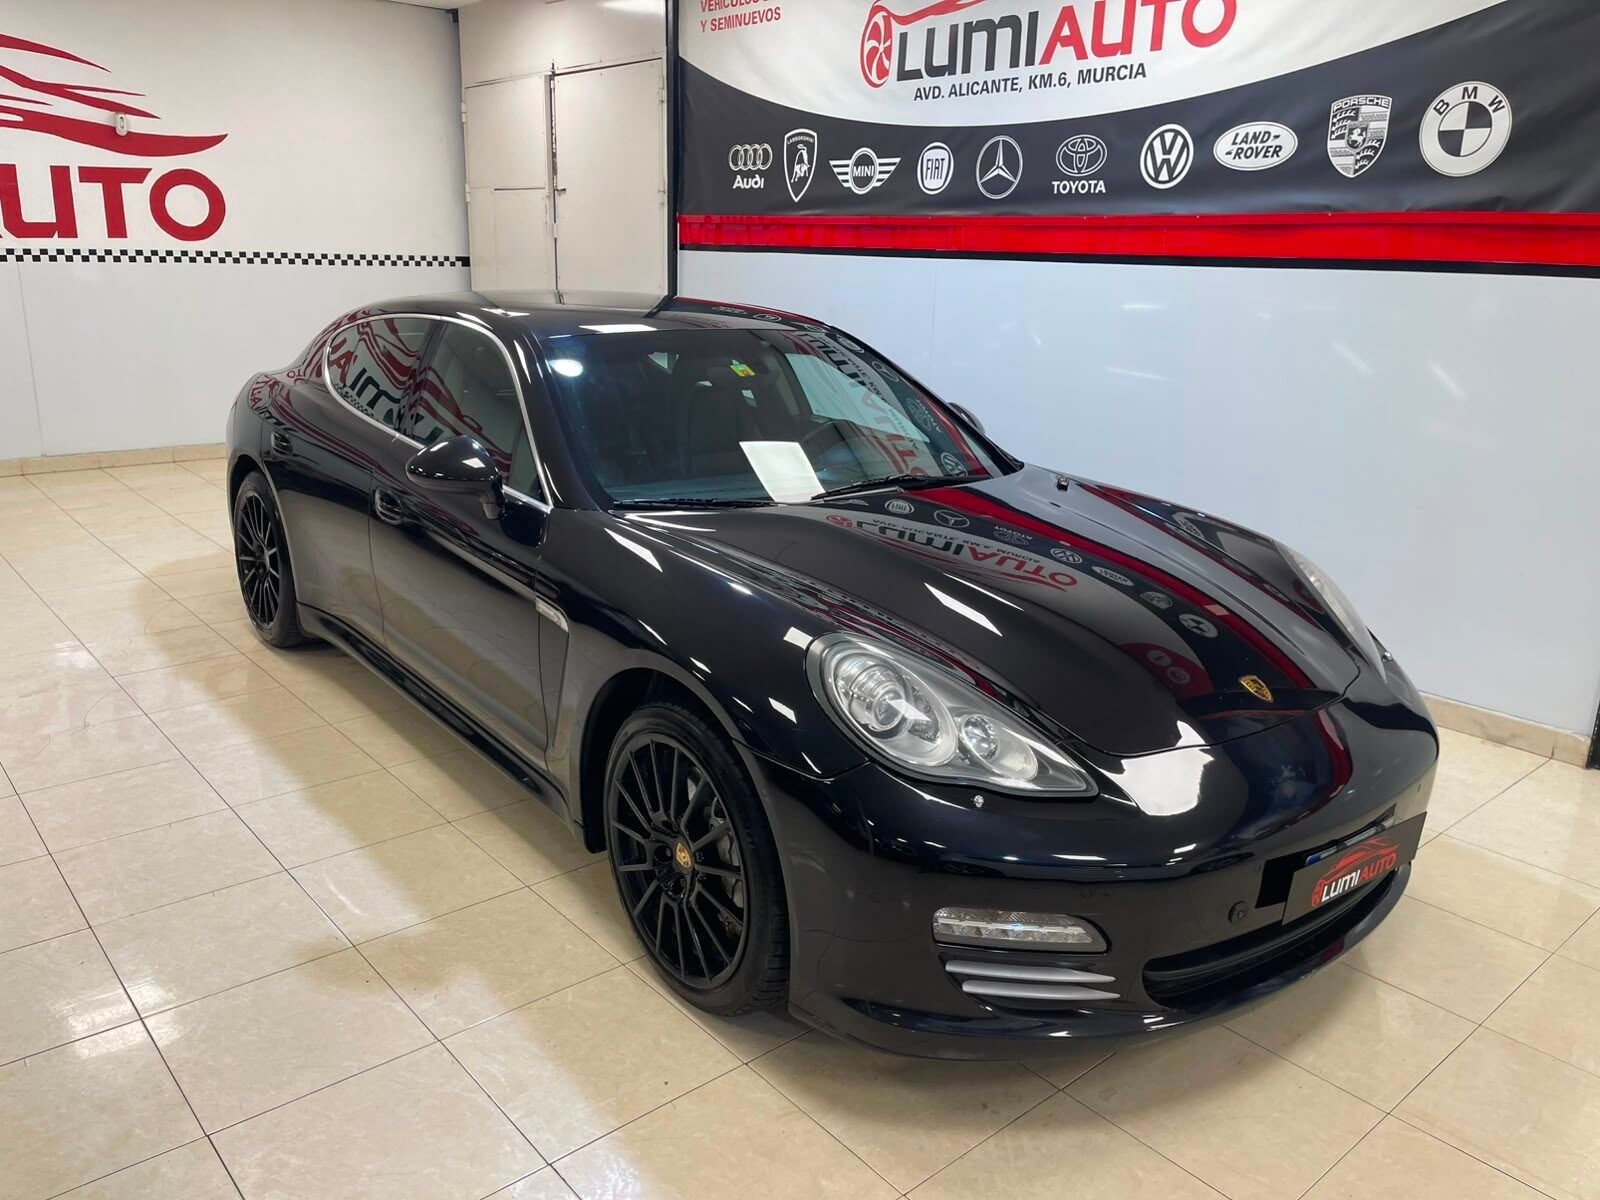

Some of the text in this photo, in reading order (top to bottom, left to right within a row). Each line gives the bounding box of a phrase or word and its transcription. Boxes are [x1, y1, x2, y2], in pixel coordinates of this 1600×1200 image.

[700, 6, 781, 33] Y SEMINUEVOS
[913, 62, 1147, 101] AVD. ALICANTE, KM.6, MURCIA
[1334, 97, 1390, 112] PORSCHE
[1433, 86, 1505, 116] BMW
[1232, 144, 1283, 160] ROVER
[852, 165, 875, 177] MINI
[924, 157, 946, 181] FIAT
[732, 173, 765, 189] Audi
[1051, 179, 1107, 194] TOYOTA
[0, 163, 227, 242] UTO
